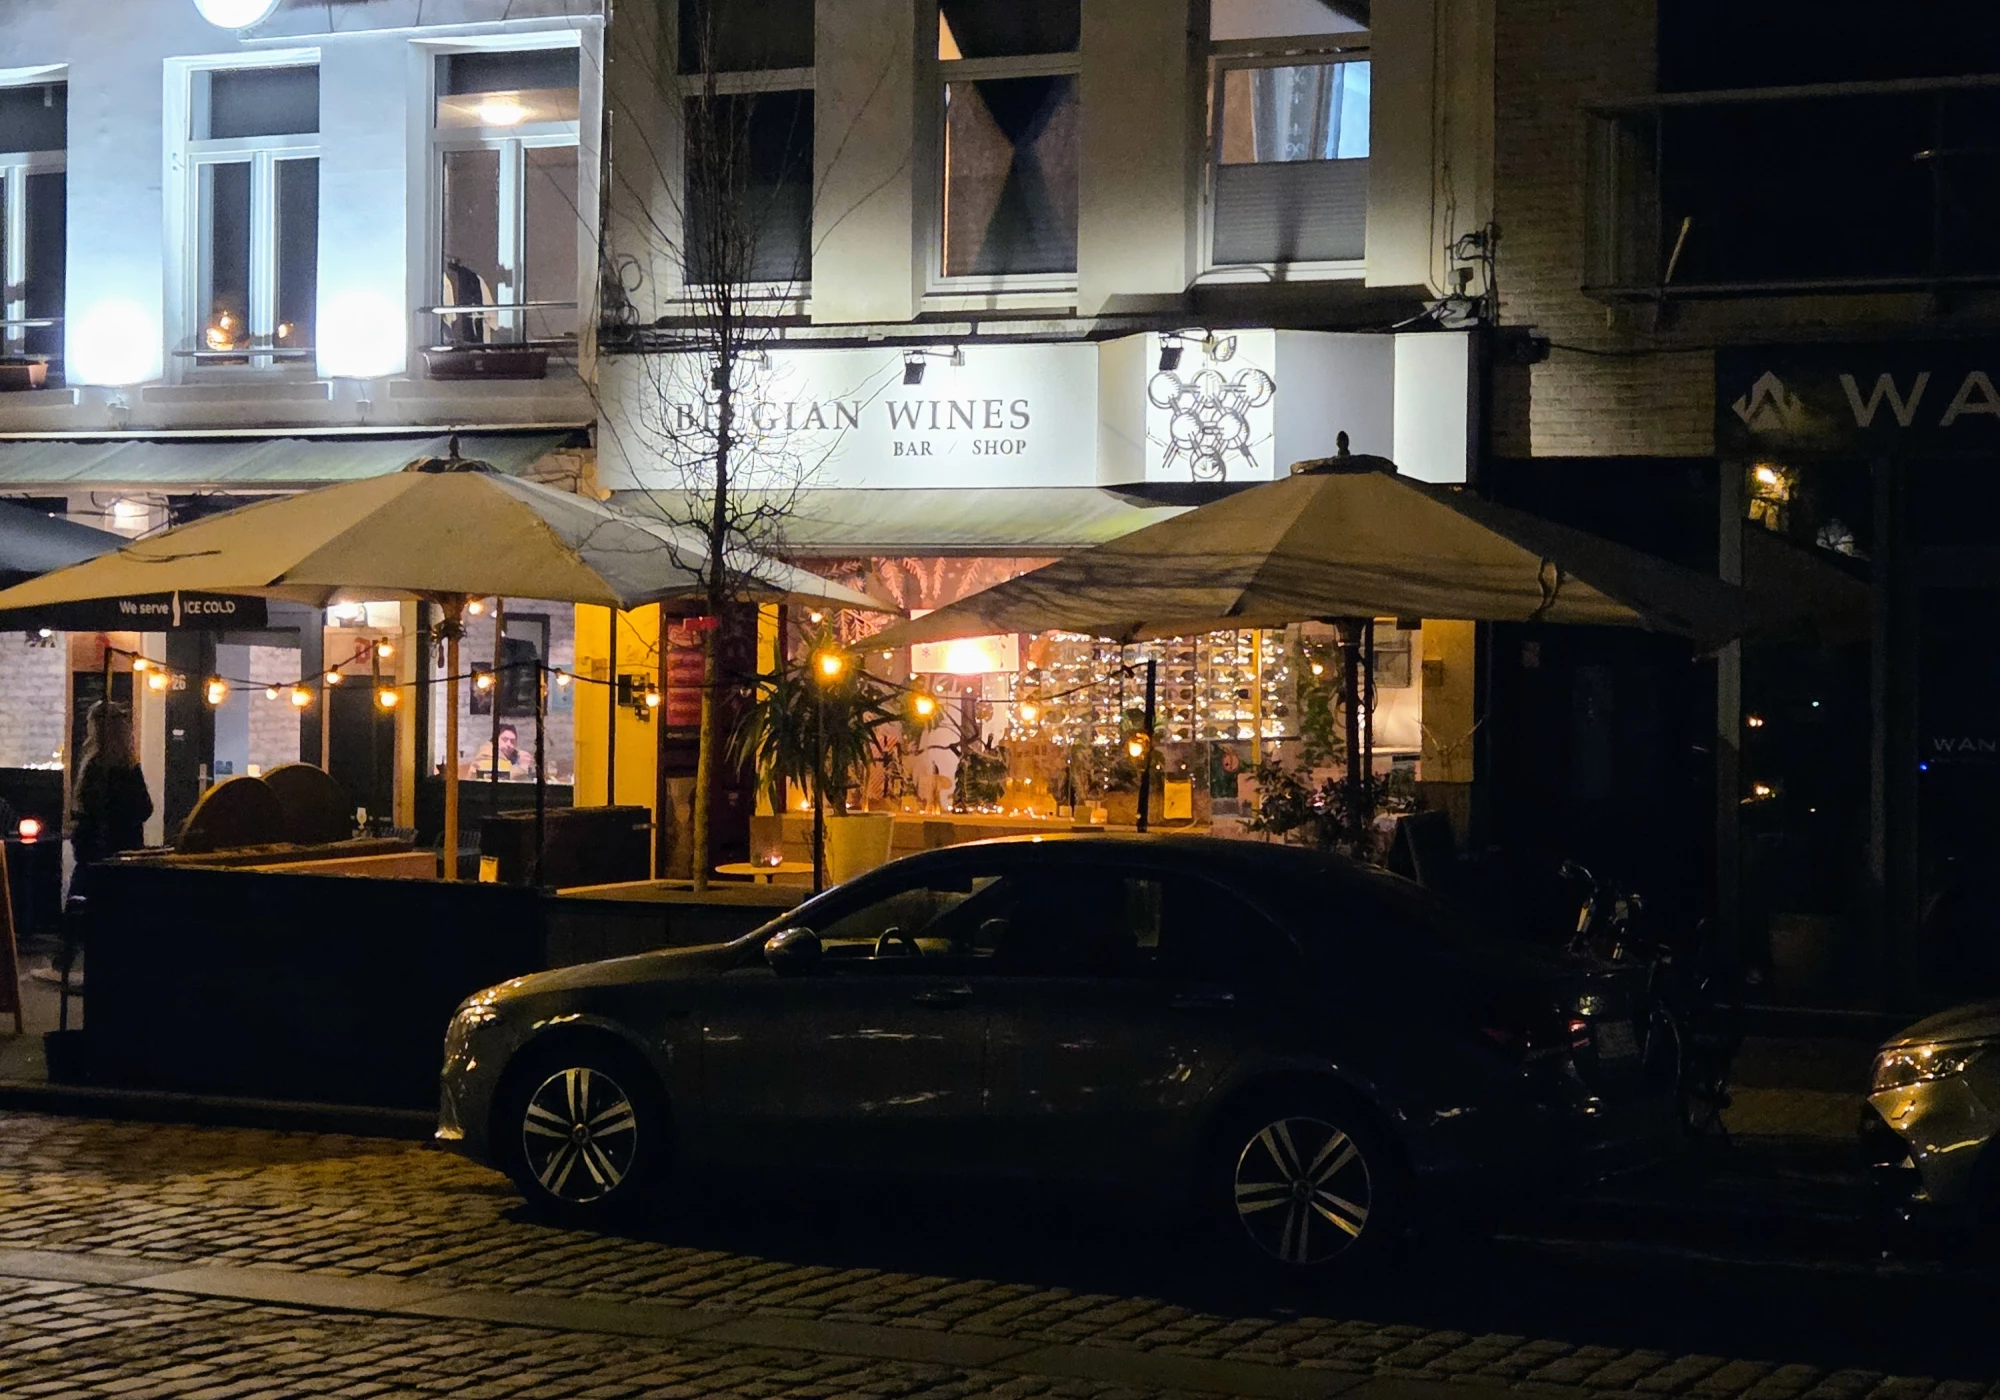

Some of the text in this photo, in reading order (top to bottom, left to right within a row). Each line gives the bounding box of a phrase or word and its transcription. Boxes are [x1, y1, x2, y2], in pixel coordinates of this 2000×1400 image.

[885, 399, 1031, 430] WINES
[893, 440, 933, 457] BAR
[972, 439, 1027, 455] SHOP
[119, 601, 236, 614] We serve ICE COLD
